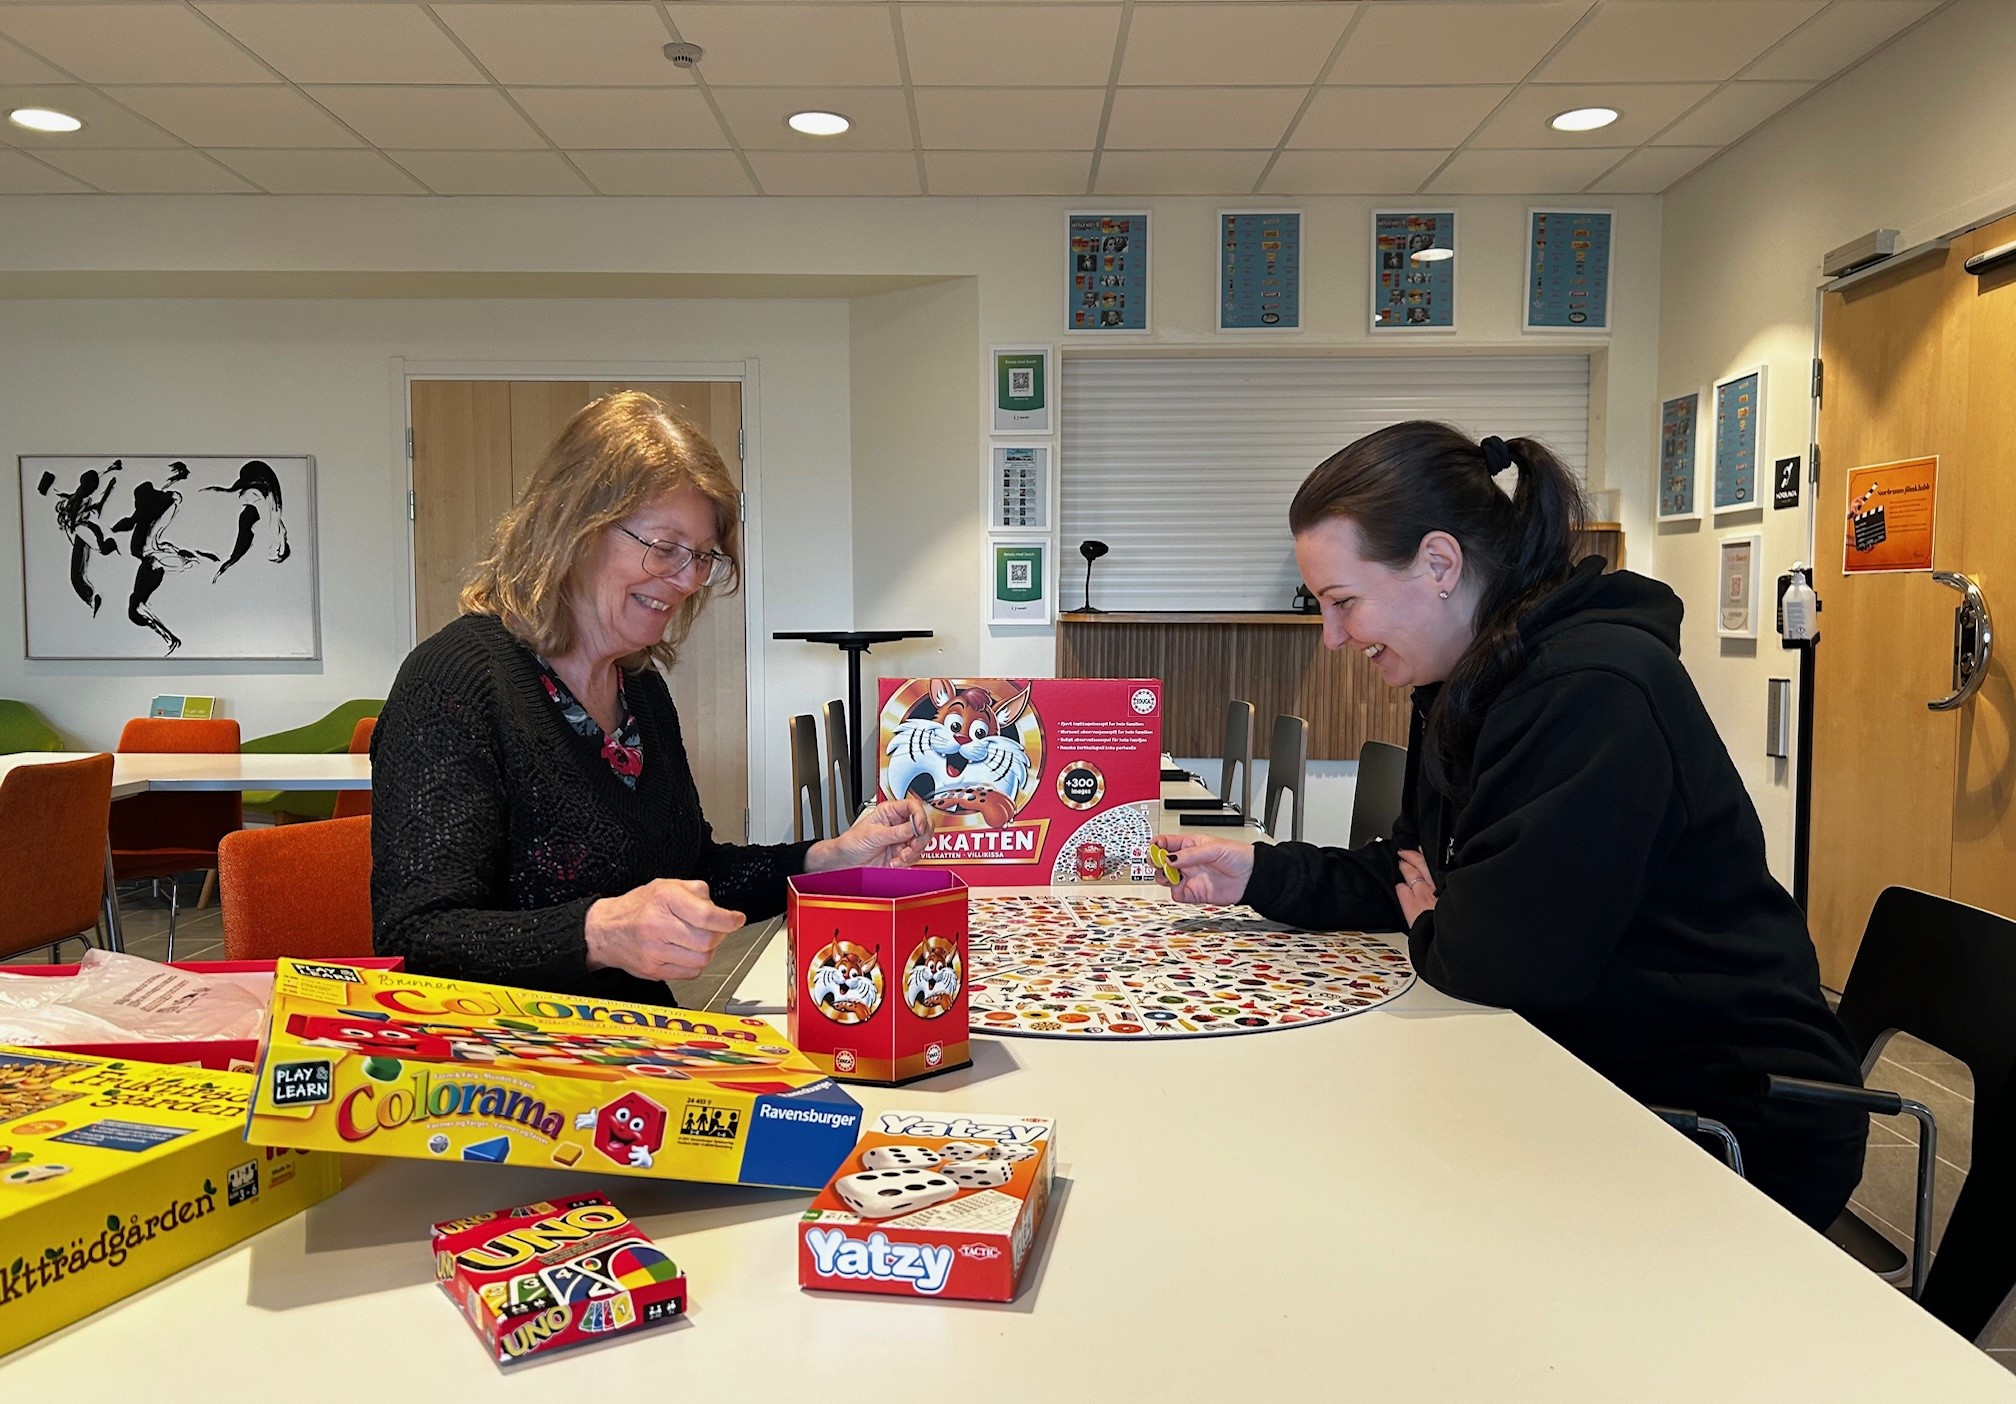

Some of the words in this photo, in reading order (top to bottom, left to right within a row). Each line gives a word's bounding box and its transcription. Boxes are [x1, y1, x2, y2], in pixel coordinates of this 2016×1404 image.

[1065, 778, 1094, 788] +300
[295, 964, 335, 975] PLAY
[300, 969, 358, 982] LEARN
[372, 989, 758, 1043] Colorama
[277, 1068, 313, 1084] PLAY
[315, 1066, 328, 1081] &
[276, 1082, 328, 1100] LEARN
[90, 1092, 246, 1117] gården
[337, 1071, 565, 1142] Colorama
[427, 1121, 454, 1129] Former
[760, 1104, 856, 1129] Ravensburger
[880, 1114, 1049, 1145] Yatzy
[438, 1211, 498, 1235] UNO
[456, 1204, 632, 1274] UNO
[805, 1227, 954, 1294] Yatzy
[963, 1246, 998, 1257] TACTIC
[437, 1250, 456, 1281] UNO
[555, 1268, 573, 1280] 4
[523, 1278, 540, 1289] 3
[618, 1303, 627, 1315] 1
[500, 1304, 573, 1357] UNO
